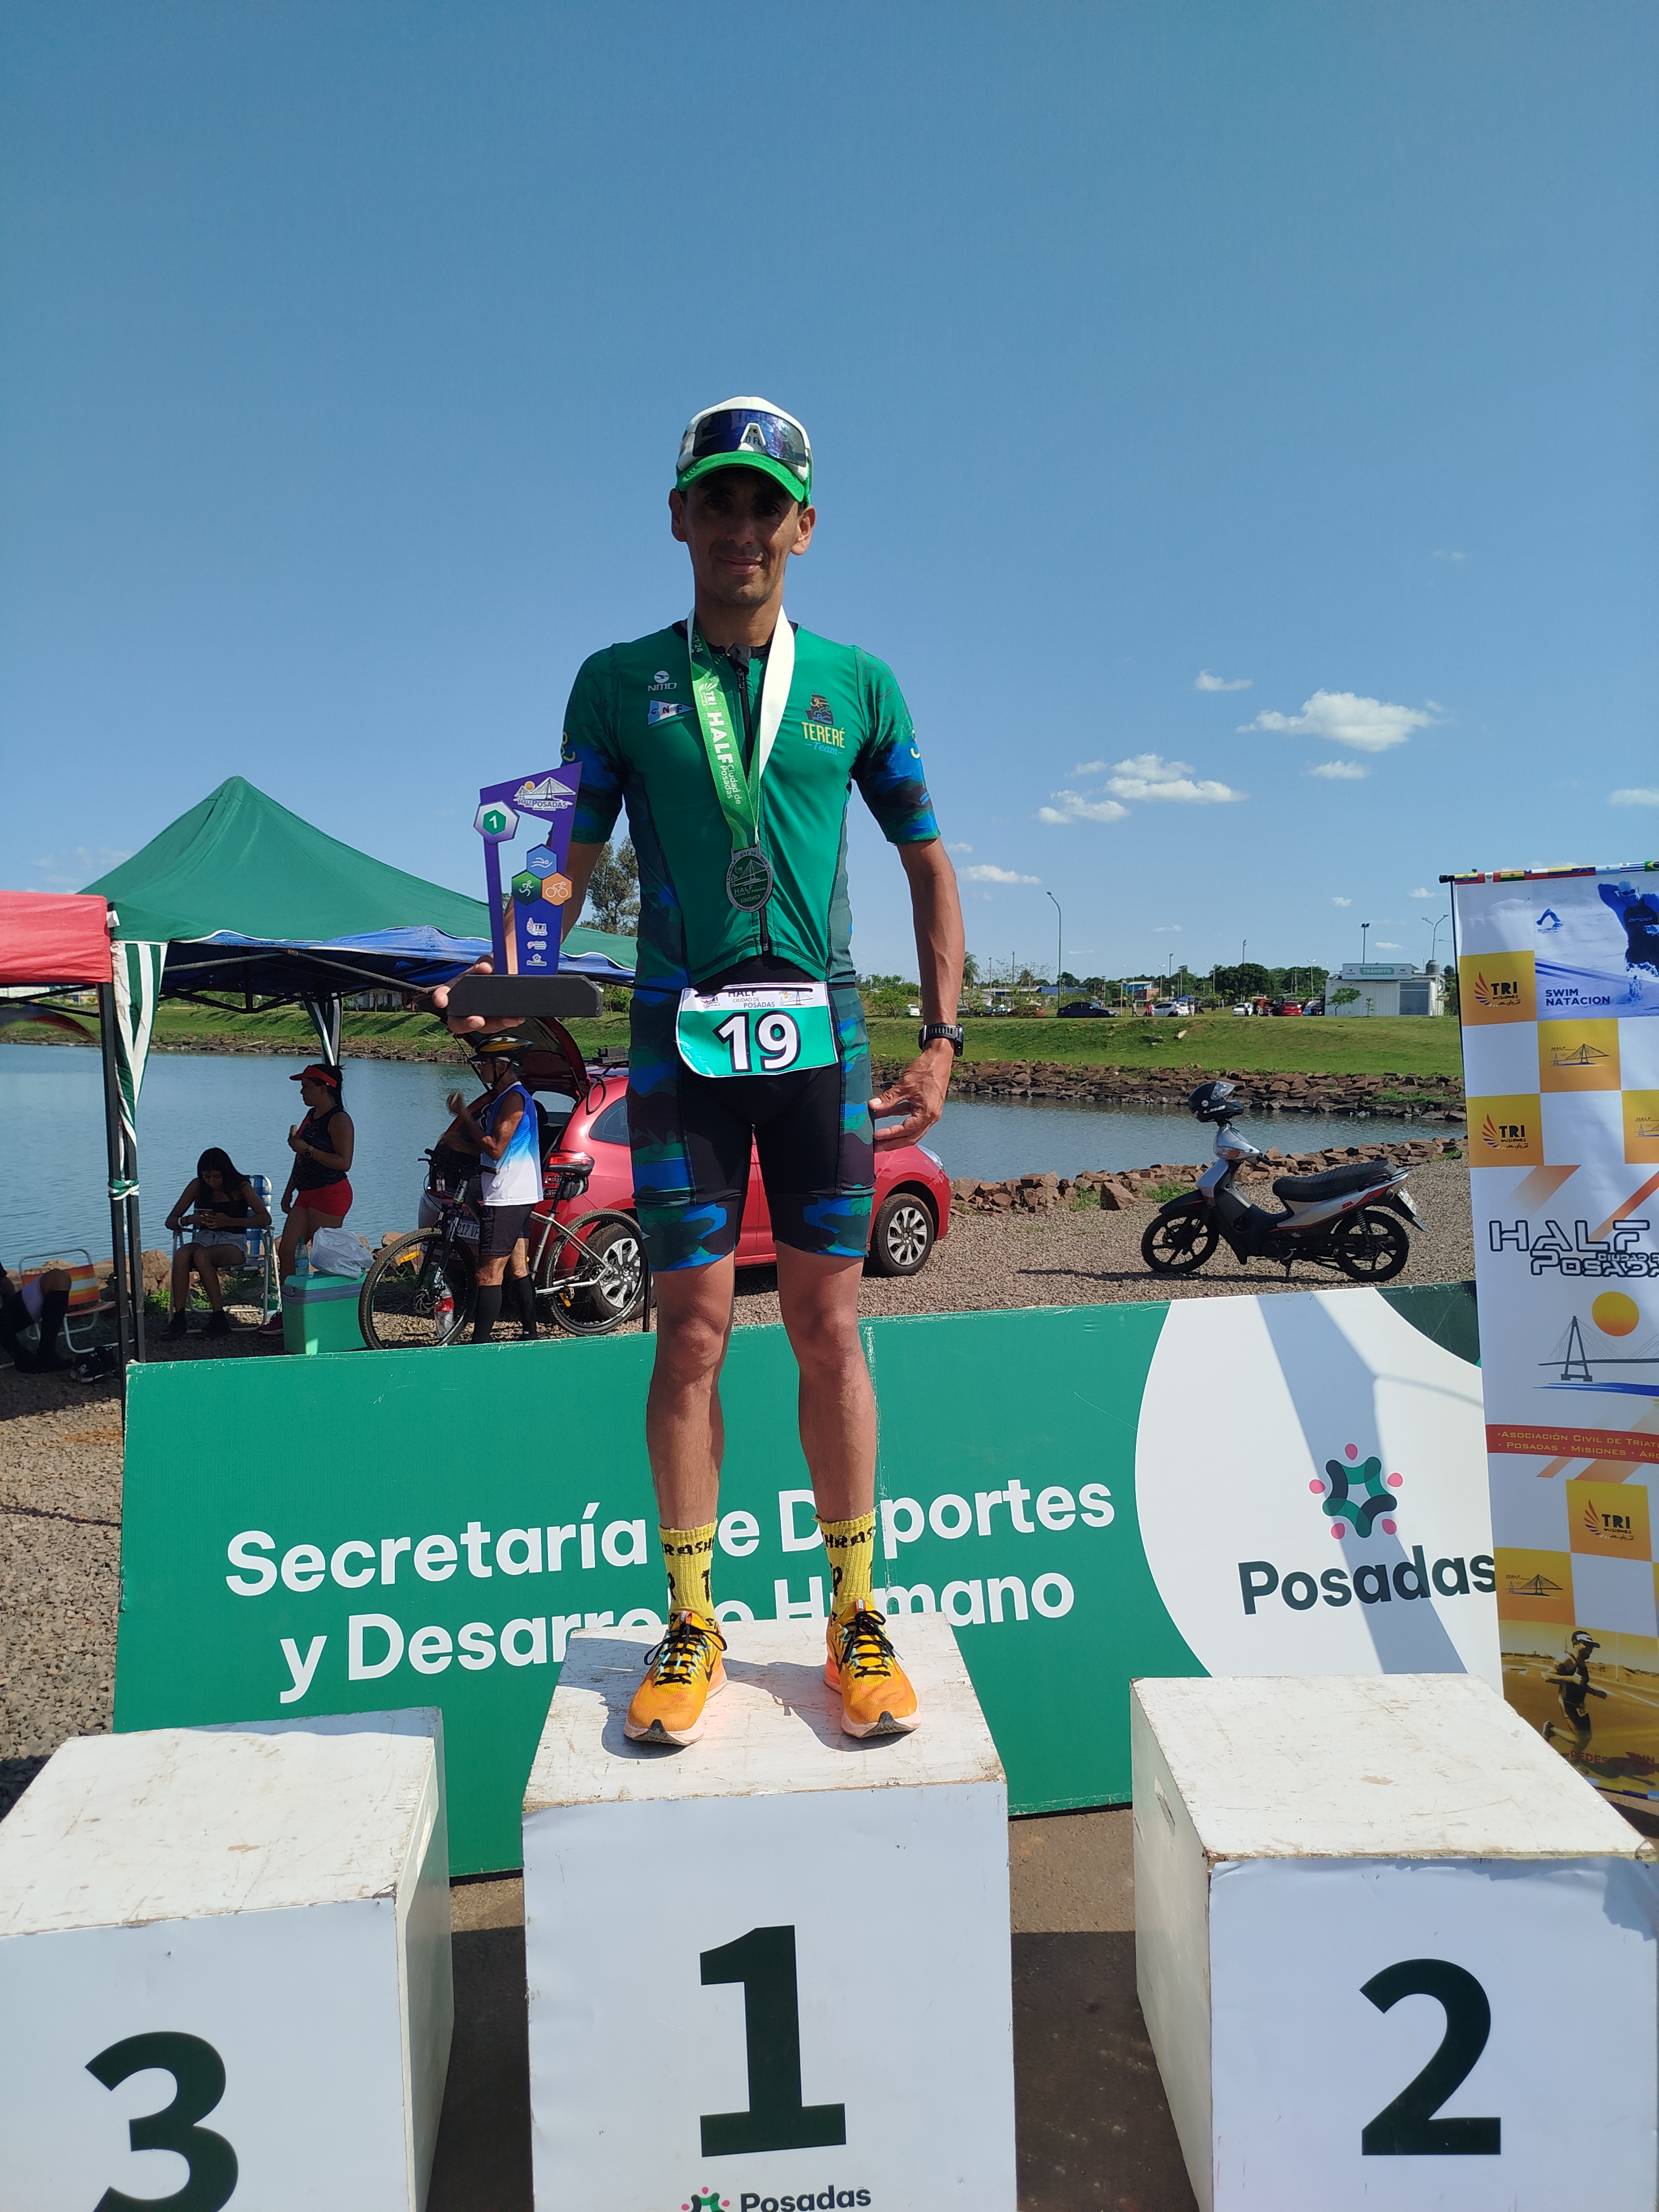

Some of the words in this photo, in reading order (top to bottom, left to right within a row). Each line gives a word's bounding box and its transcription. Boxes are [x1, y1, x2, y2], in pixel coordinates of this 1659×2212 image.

[706, 691, 717, 705] TRI
[707, 712, 733, 763] HALF
[801, 722, 846, 748] TERERÉ
[813, 742, 838, 755] Team
[727, 764, 742, 792] Ciudad
[734, 794, 743, 805] de
[489, 816, 498, 829] 1
[734, 885, 753, 894] HALF
[741, 895, 760, 904] FINISHER
[1491, 982, 1517, 995] TRI
[1545, 989, 1578, 997] SWIM
[1546, 996, 1610, 1006] NATACION
[712, 1010, 801, 1073] 19
[1499, 1124, 1526, 1138] TRI
[1489, 1220, 1650, 1252] HALF
[1597, 1253, 1648, 1261] CIUDAD
[1501, 1431, 1568, 1441] ASOCIACIÓN
[1506, 1442, 1558, 1451] POSADAS
[1571, 1446, 1626, 1455] MISIONES
[1601, 1514, 1630, 1529] TRI
[226, 1502, 648, 1597] Secretaría
[778, 1479, 1115, 1560] Dportes
[1238, 1545, 1496, 1615] Posadas
[279, 1635, 327, 1705] y
[775, 1572, 1074, 1627] Hmano
[700, 1924, 846, 2157] 1
[1359, 1958, 1501, 2156] 2
[85, 2031, 238, 2212] 3
[740, 2184, 872, 2212] Posadas
